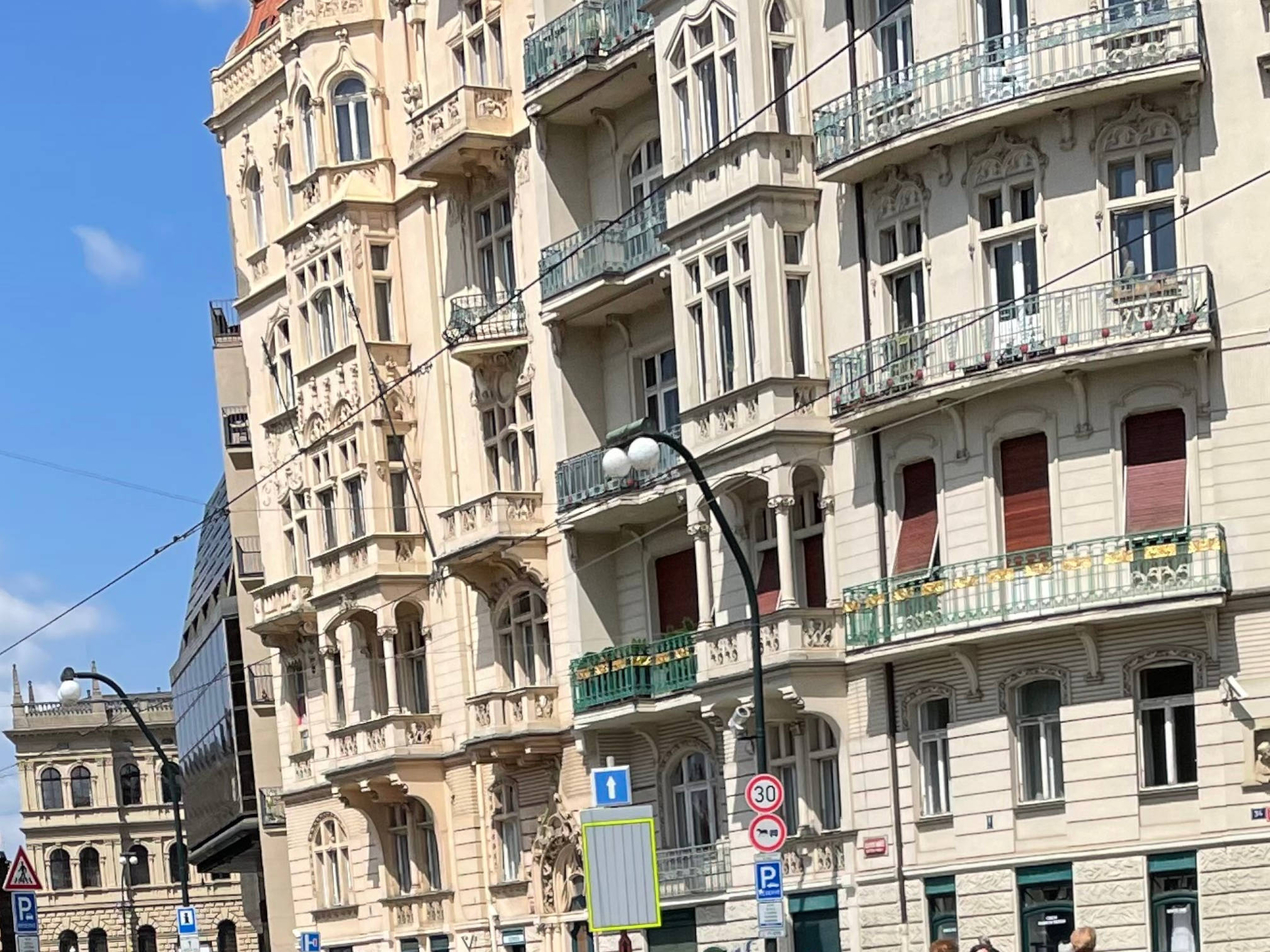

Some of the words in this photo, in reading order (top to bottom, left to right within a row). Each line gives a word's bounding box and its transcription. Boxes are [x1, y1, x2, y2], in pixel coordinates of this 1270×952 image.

[754, 785, 776, 803] 30
[760, 866, 776, 889] P
[18, 896, 32, 921] P
